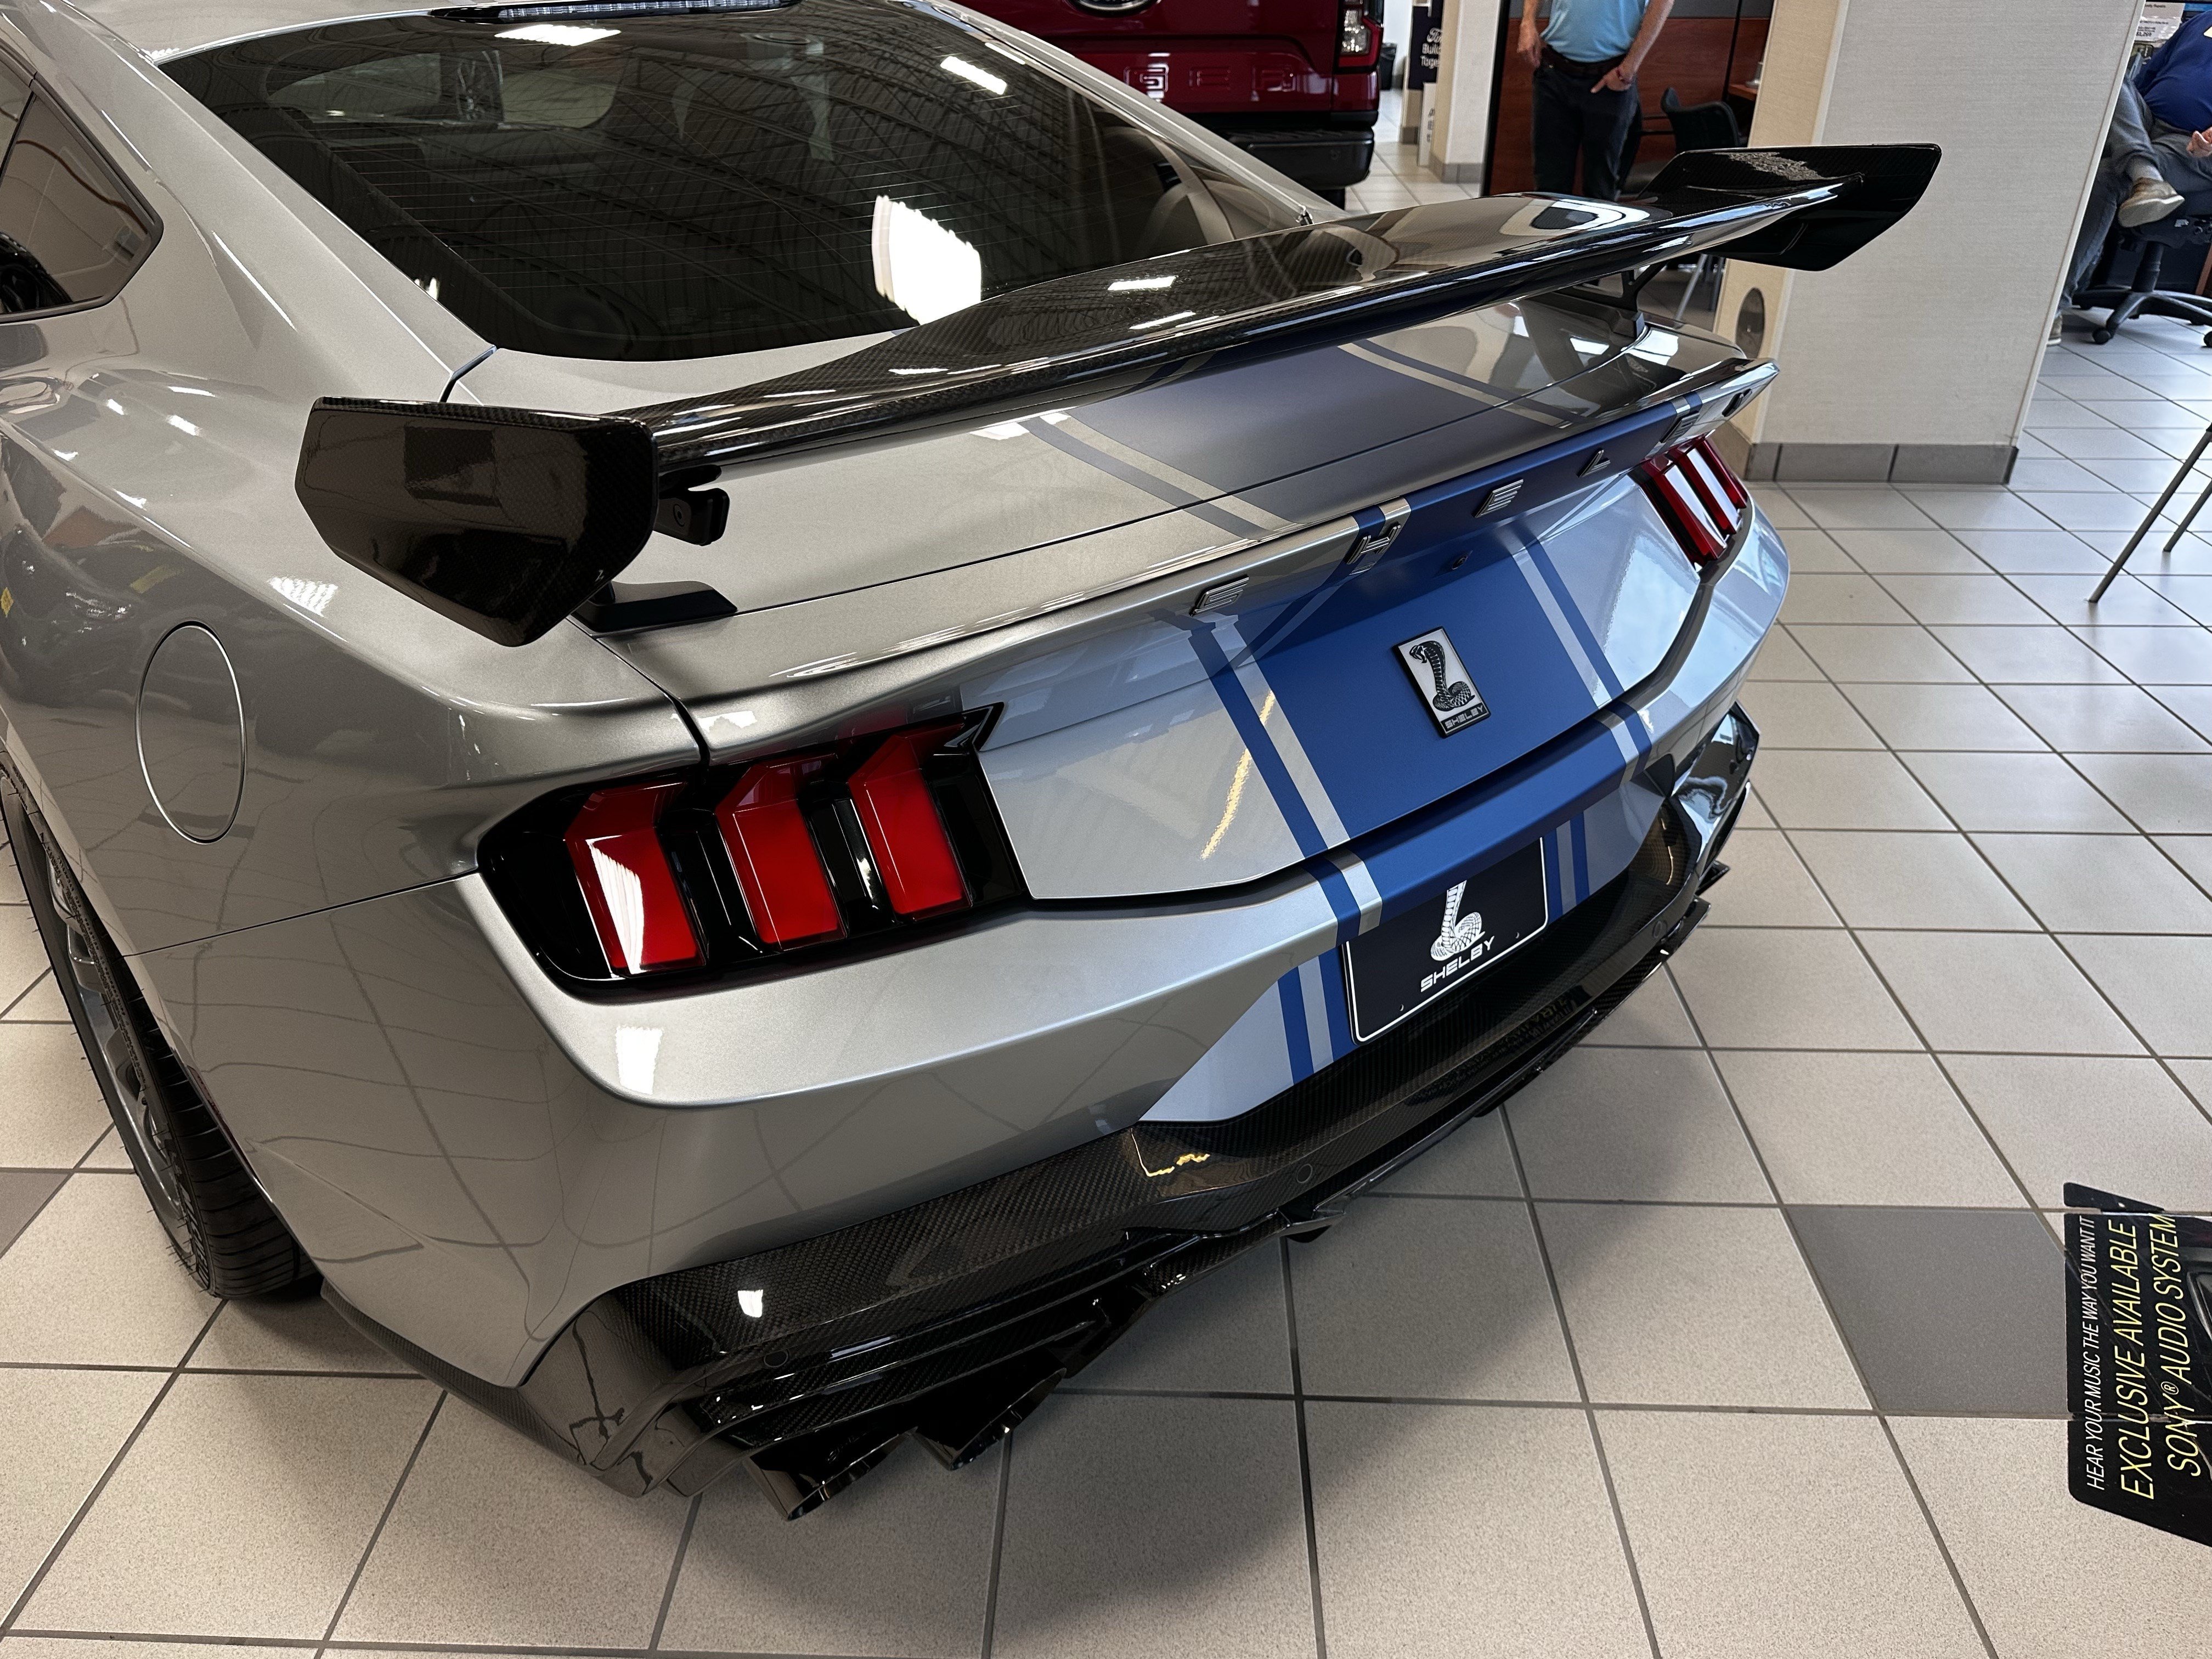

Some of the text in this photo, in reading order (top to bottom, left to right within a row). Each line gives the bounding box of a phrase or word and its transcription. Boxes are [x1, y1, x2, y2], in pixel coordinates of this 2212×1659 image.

[1124, 63, 1297, 94] GER
[1444, 704, 1483, 729] SHELBY
[1420, 936, 1495, 992] SHELBY
[2149, 1213, 2184, 1300] SYSTEM
[2079, 1215, 2104, 1490] HEAR YOUR MUSIC THE WAY YOU WANT IT
[2108, 1220, 2154, 1499] EXCLUSIVE AVAILABLE
[2155, 1302, 2192, 1385] AUDIO
